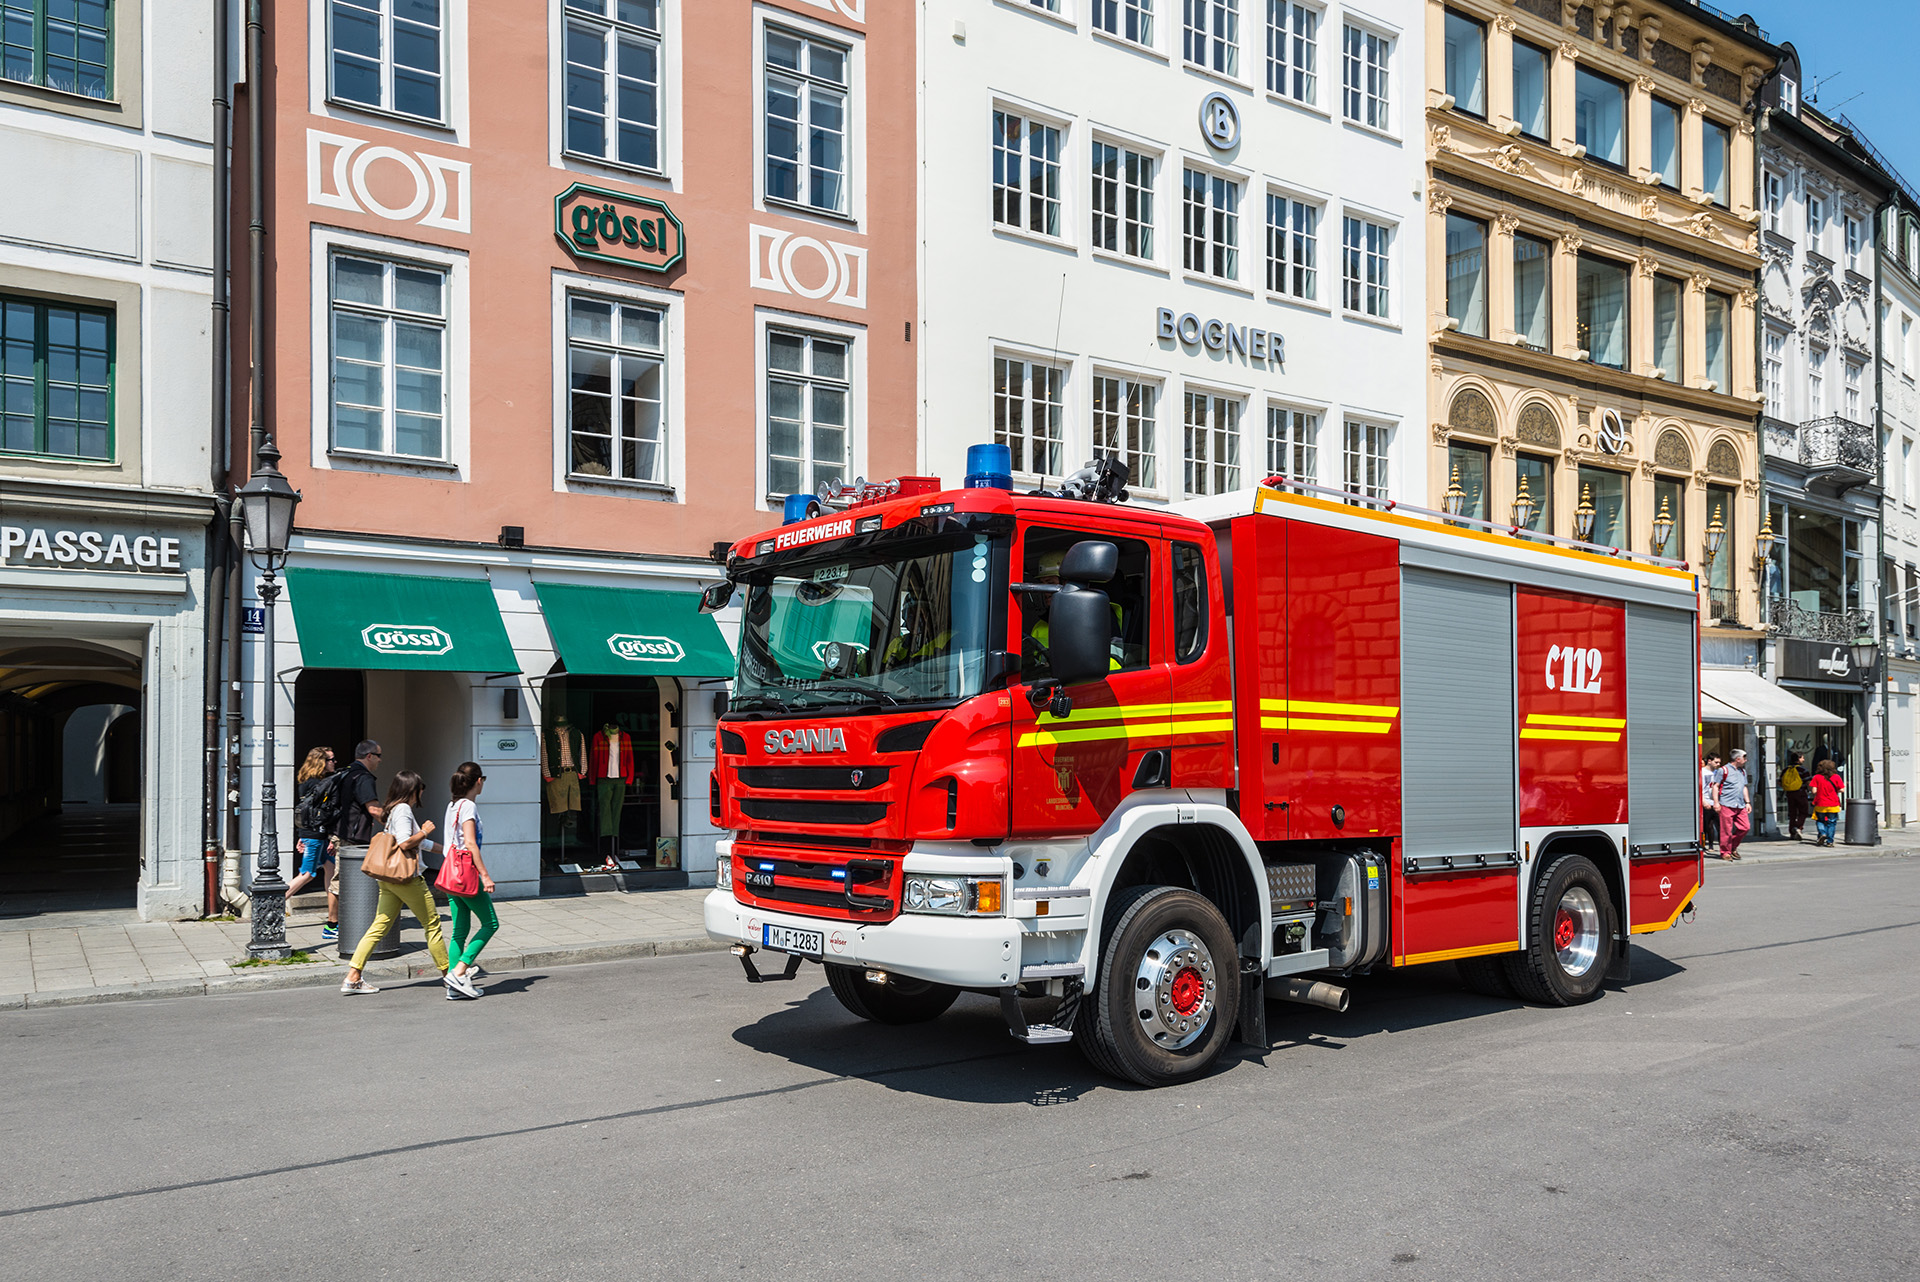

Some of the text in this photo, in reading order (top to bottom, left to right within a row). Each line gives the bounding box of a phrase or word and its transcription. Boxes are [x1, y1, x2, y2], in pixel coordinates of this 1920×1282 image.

[572, 203, 667, 251] gössl
[1157, 306, 1286, 364] BOGNER
[1, 526, 181, 568] PASSAGE
[776, 519, 852, 549] FEUERWEHR
[247, 609, 261, 622] 14
[374, 630, 441, 649] gössl
[618, 640, 675, 656] gössl
[1560, 646, 1602, 694] 112
[764, 728, 847, 754] SCANIA
[753, 874, 772, 886] 410
